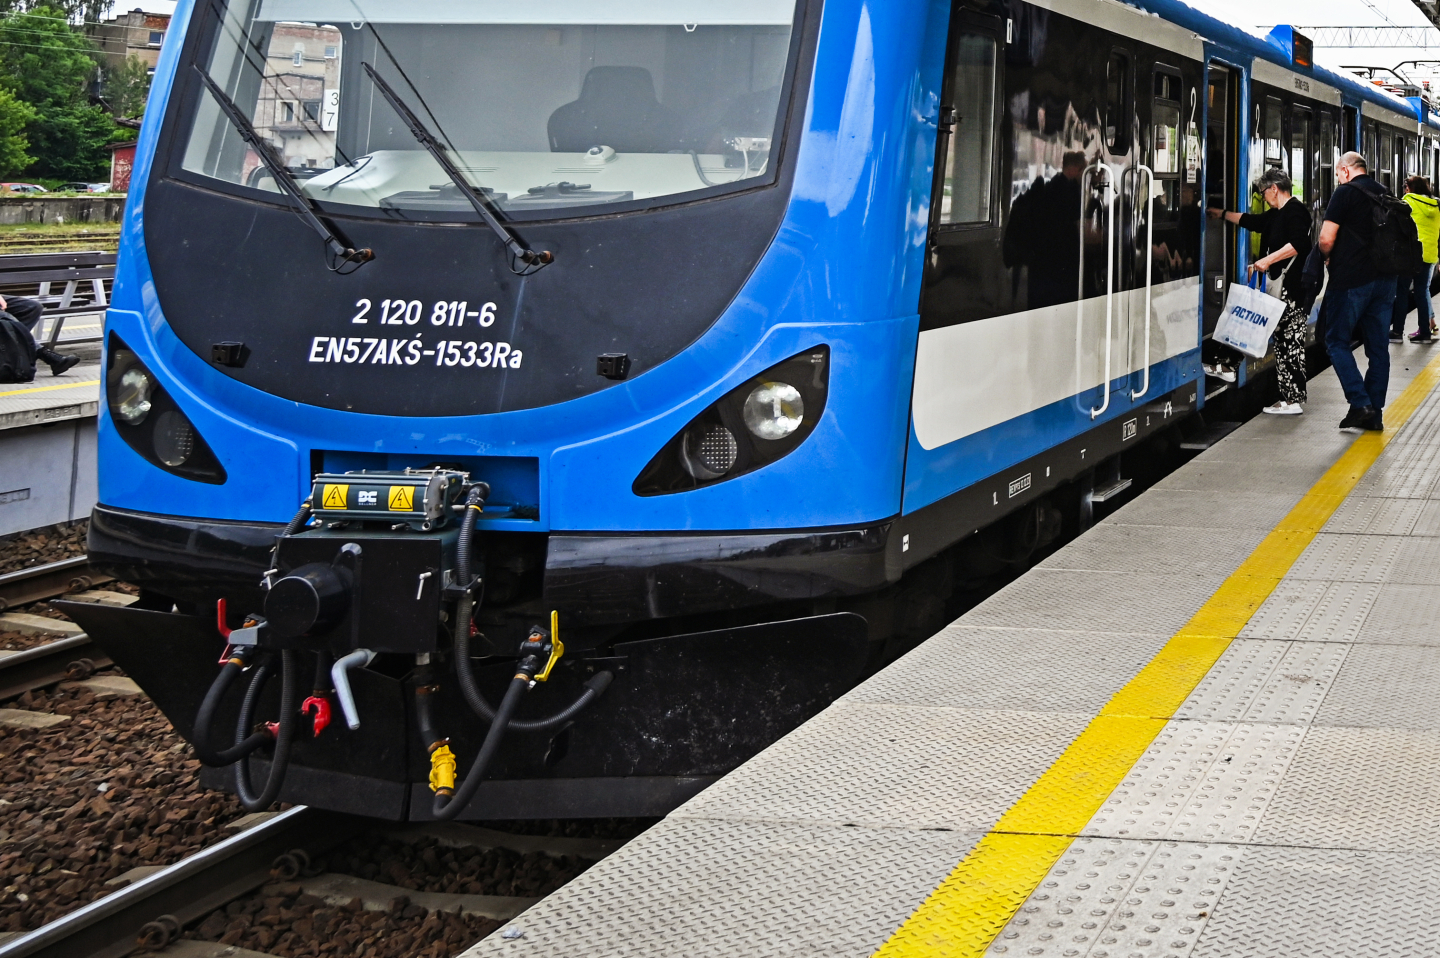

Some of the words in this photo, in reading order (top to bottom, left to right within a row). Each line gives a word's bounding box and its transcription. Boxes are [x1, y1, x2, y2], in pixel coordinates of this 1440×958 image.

[331, 92, 339, 106] 3
[1190, 86, 1196, 129] 2
[327, 112, 335, 127] 7
[352, 298, 372, 324] 2
[380, 299, 423, 325] 120
[431, 300, 498, 327] 811-6
[1231, 305, 1269, 327] ACTION
[308, 332, 523, 369] EN57AKŚ-1533Ra
